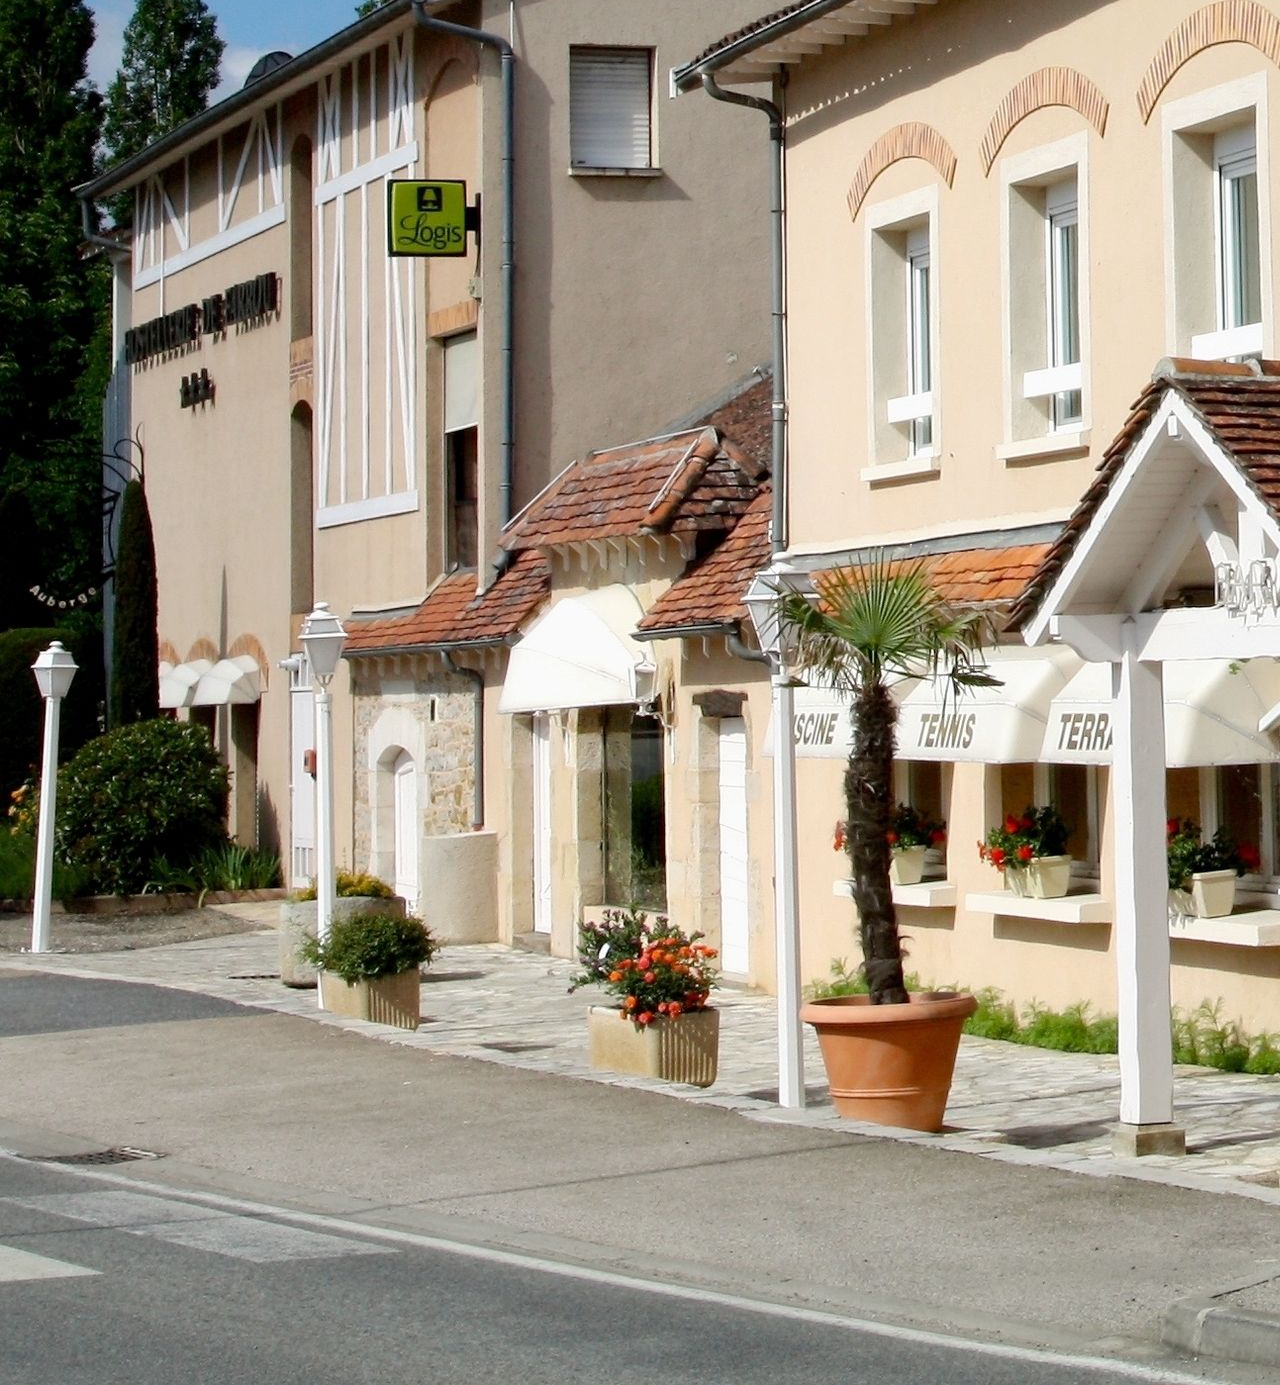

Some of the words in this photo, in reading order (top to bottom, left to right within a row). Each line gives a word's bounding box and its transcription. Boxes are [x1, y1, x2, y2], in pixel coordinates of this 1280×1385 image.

[397, 213, 462, 251] Logis
[29, 585, 96, 609] Auberge
[917, 713, 976, 749] TENNIS
